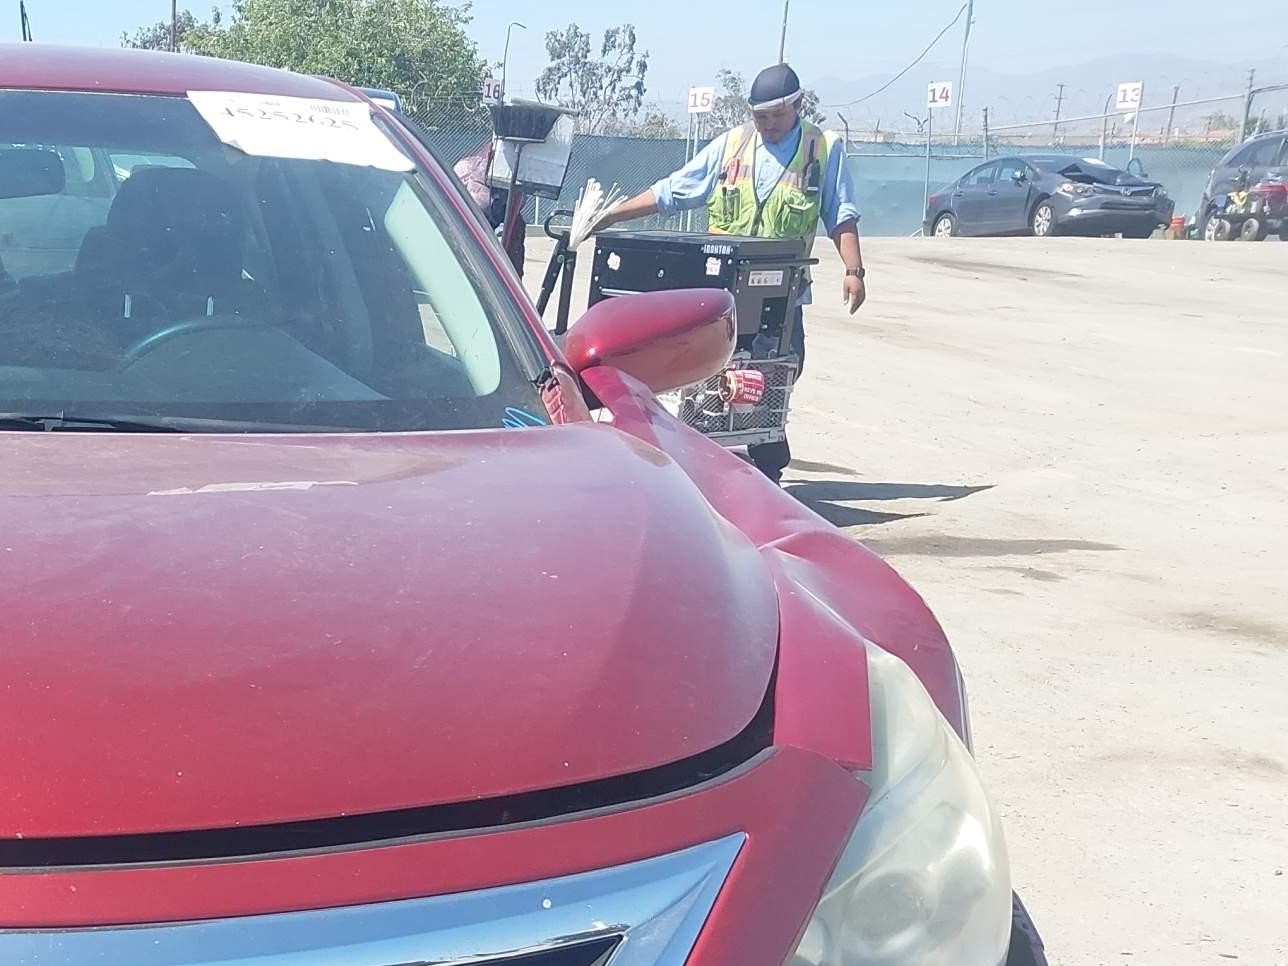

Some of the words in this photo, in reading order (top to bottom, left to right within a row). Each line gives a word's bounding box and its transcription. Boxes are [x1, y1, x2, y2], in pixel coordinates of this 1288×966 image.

[484, 83, 500, 99] 16
[928, 86, 950, 103] 14
[1118, 87, 1140, 103] 13
[689, 92, 712, 107] 15
